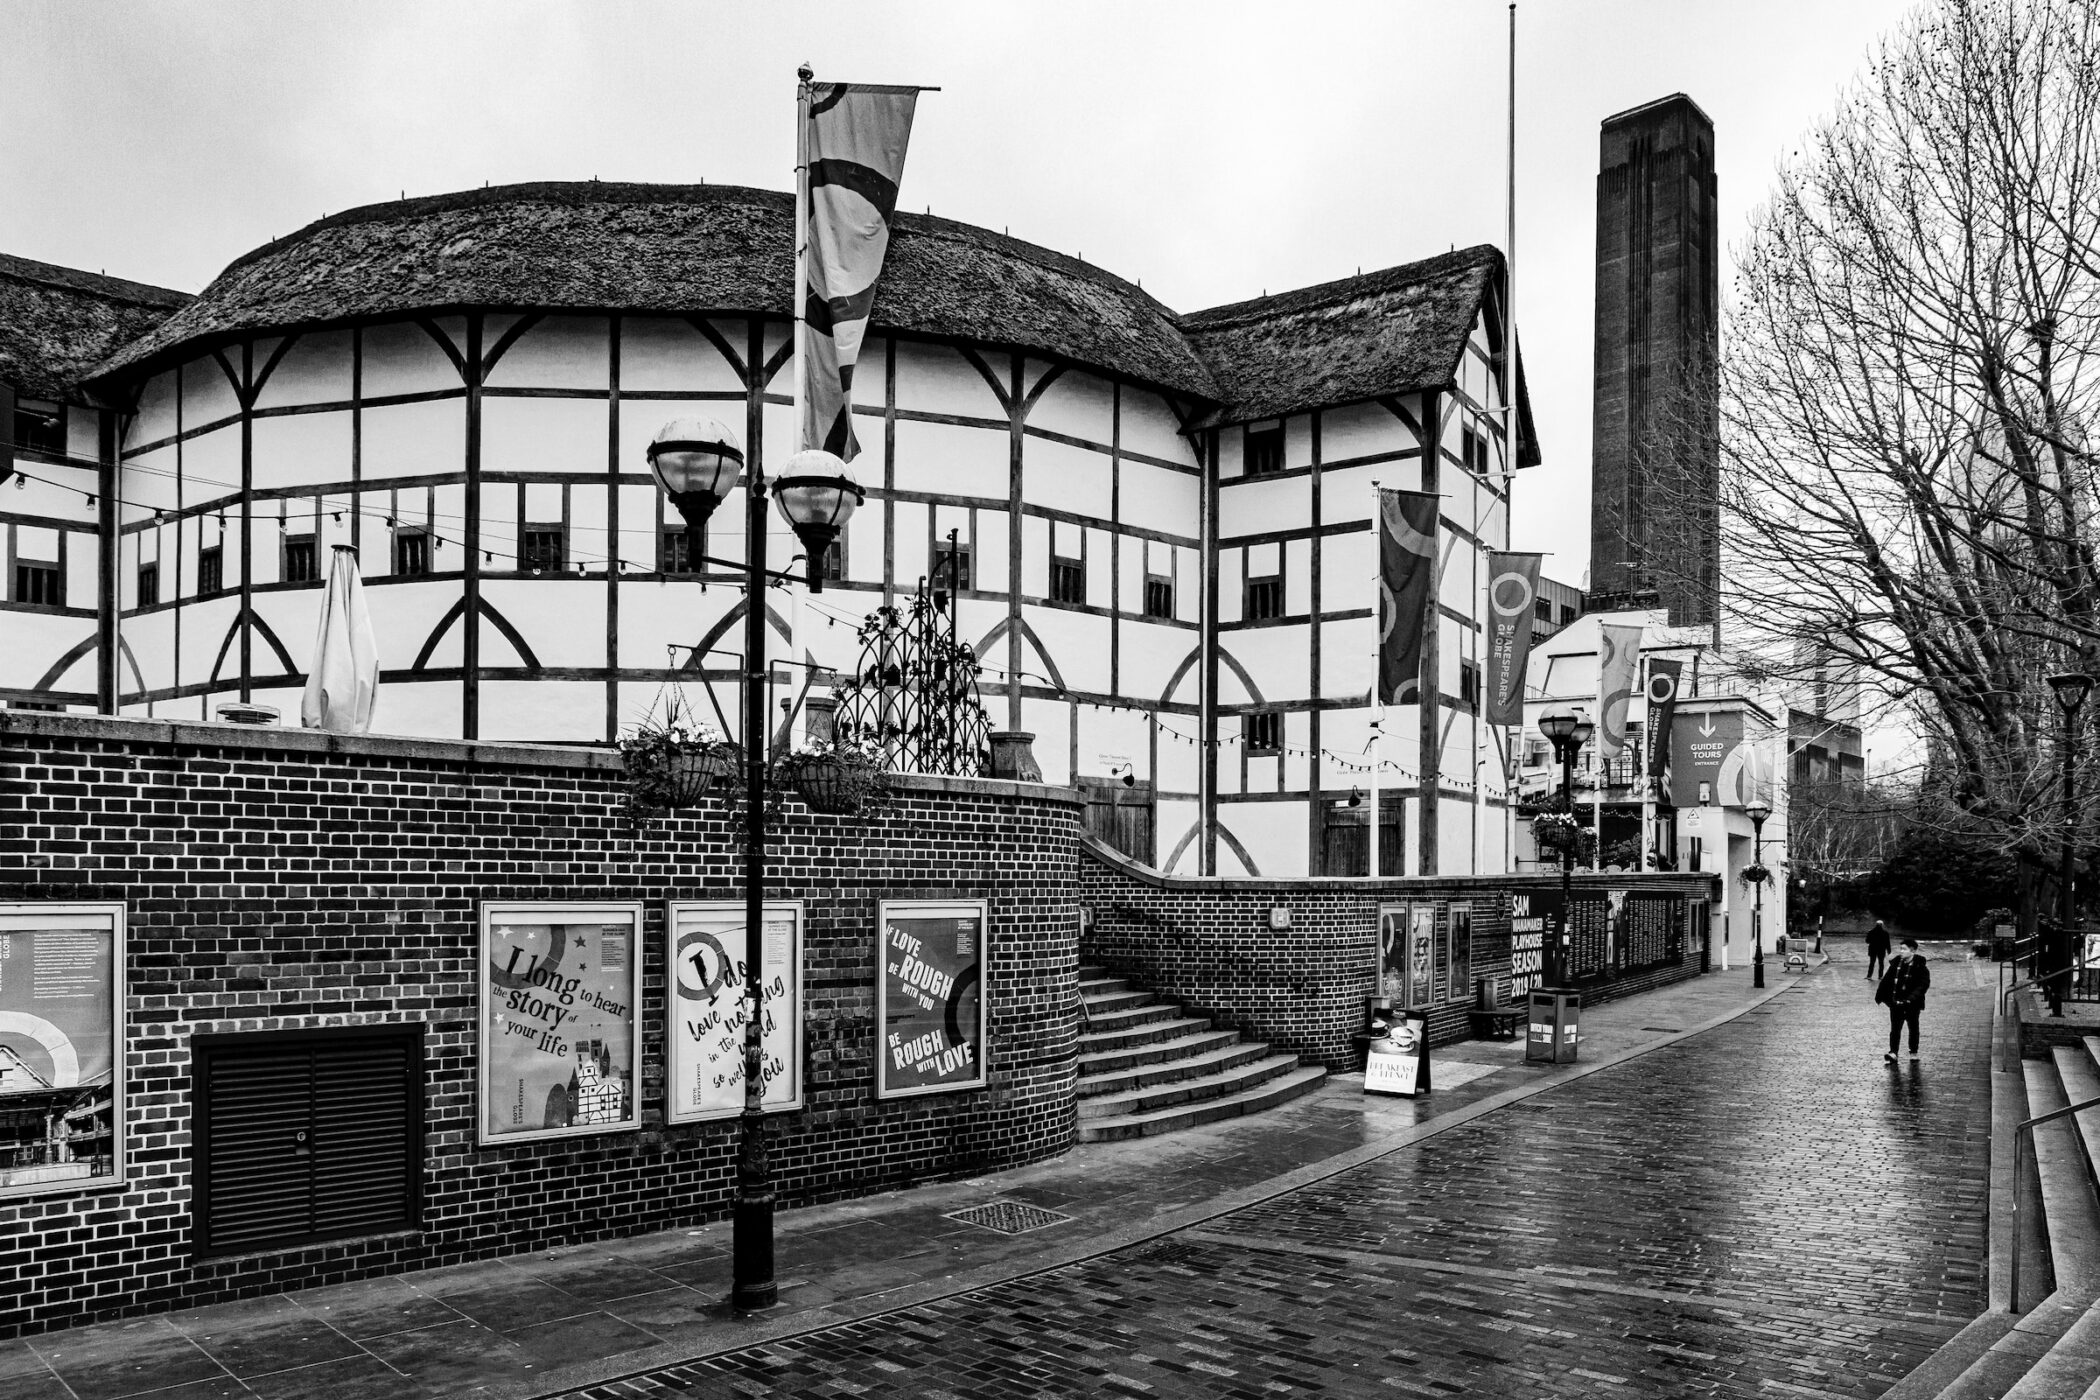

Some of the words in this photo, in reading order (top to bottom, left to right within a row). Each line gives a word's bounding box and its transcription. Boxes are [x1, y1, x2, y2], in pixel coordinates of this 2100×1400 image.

[1493, 623, 1505, 659] GLOBE
[1497, 624, 1515, 706] SHAKESPEARE'S
[1690, 743, 1724, 751] GUIDED
[1693, 751, 1722, 759] TOURS
[1512, 894, 1530, 917] SAM
[1512, 917, 1543, 933] WANAMAKER
[886, 924, 894, 937] IF
[891, 929, 922, 958] LOVE
[1512, 933, 1543, 951] PLAYHOUSE
[504, 945, 525, 979] I
[521, 954, 581, 1006] long
[1512, 949, 1543, 975] SEASON
[688, 949, 719, 1007] I
[724, 954, 747, 988] do
[888, 962, 899, 975] BE
[898, 954, 954, 1001] ROUGH
[1511, 976, 1529, 998] 2019
[493, 985, 508, 998] the
[506, 990, 569, 1031] story
[568, 1015, 580, 1023] of
[580, 989, 593, 1002] to
[592, 991, 627, 1017] hear
[902, 982, 919, 999] WITH
[918, 993, 935, 1011] YOU
[505, 1021, 538, 1040] your
[537, 1031, 568, 1058] life
[687, 1010, 721, 1042] love
[888, 1032, 901, 1048] BE
[708, 1053, 719, 1063] in
[717, 1036, 737, 1053] the
[892, 1029, 944, 1070] ROUGH
[916, 1057, 936, 1073] WITH
[934, 1041, 974, 1077] LOVE
[713, 1074, 725, 1089] so
